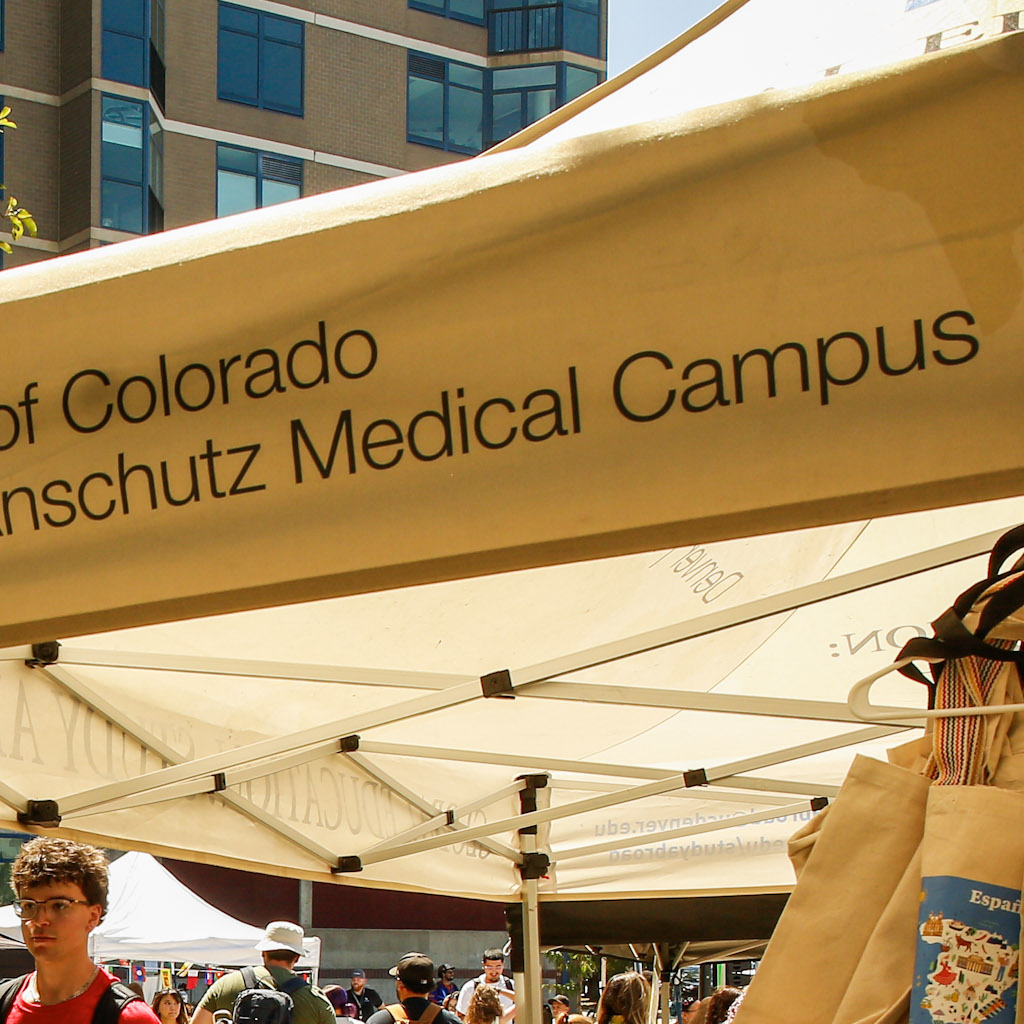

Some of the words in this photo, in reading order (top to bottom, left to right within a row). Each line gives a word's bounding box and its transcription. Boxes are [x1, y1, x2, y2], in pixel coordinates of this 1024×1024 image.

[61, 320, 378, 434] Colorado
[290, 365, 581, 484] Medical
[612, 310, 980, 423] Campus
